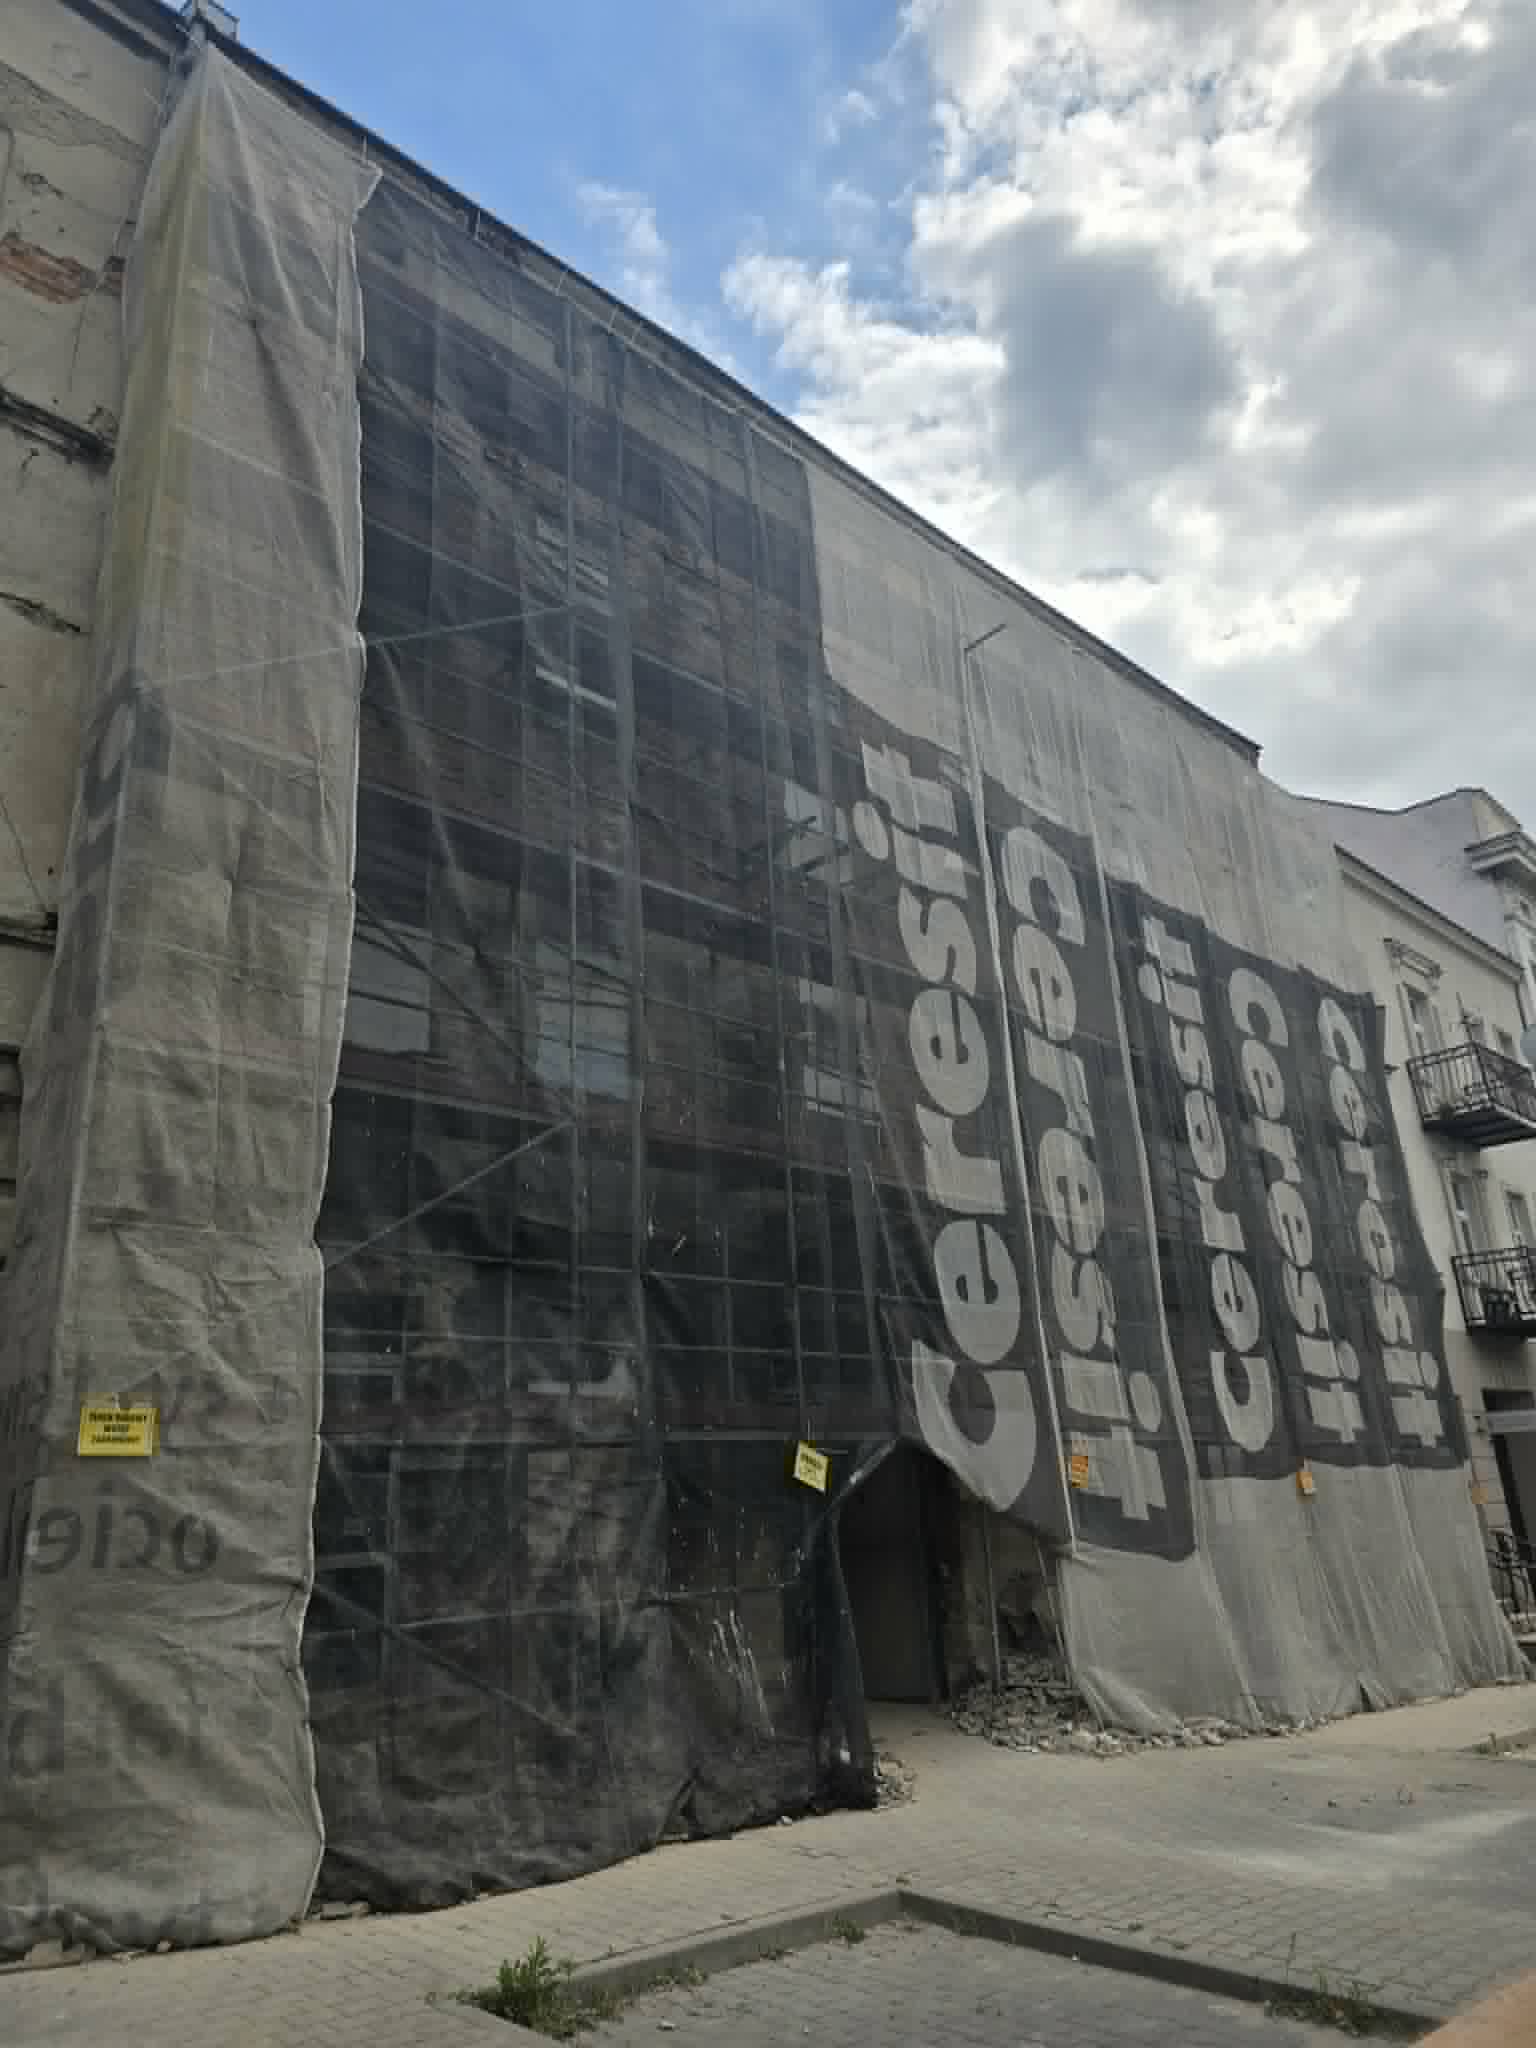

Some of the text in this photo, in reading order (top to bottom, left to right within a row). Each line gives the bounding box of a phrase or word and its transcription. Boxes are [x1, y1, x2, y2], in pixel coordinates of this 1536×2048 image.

[853, 738, 1037, 1512] Ceresit
[1001, 827, 1166, 1520] Ceresit
[1138, 916, 1273, 1451] Ceresit
[1228, 968, 1365, 1443] Ceresit
[1318, 998, 1445, 1447] Ceresit
